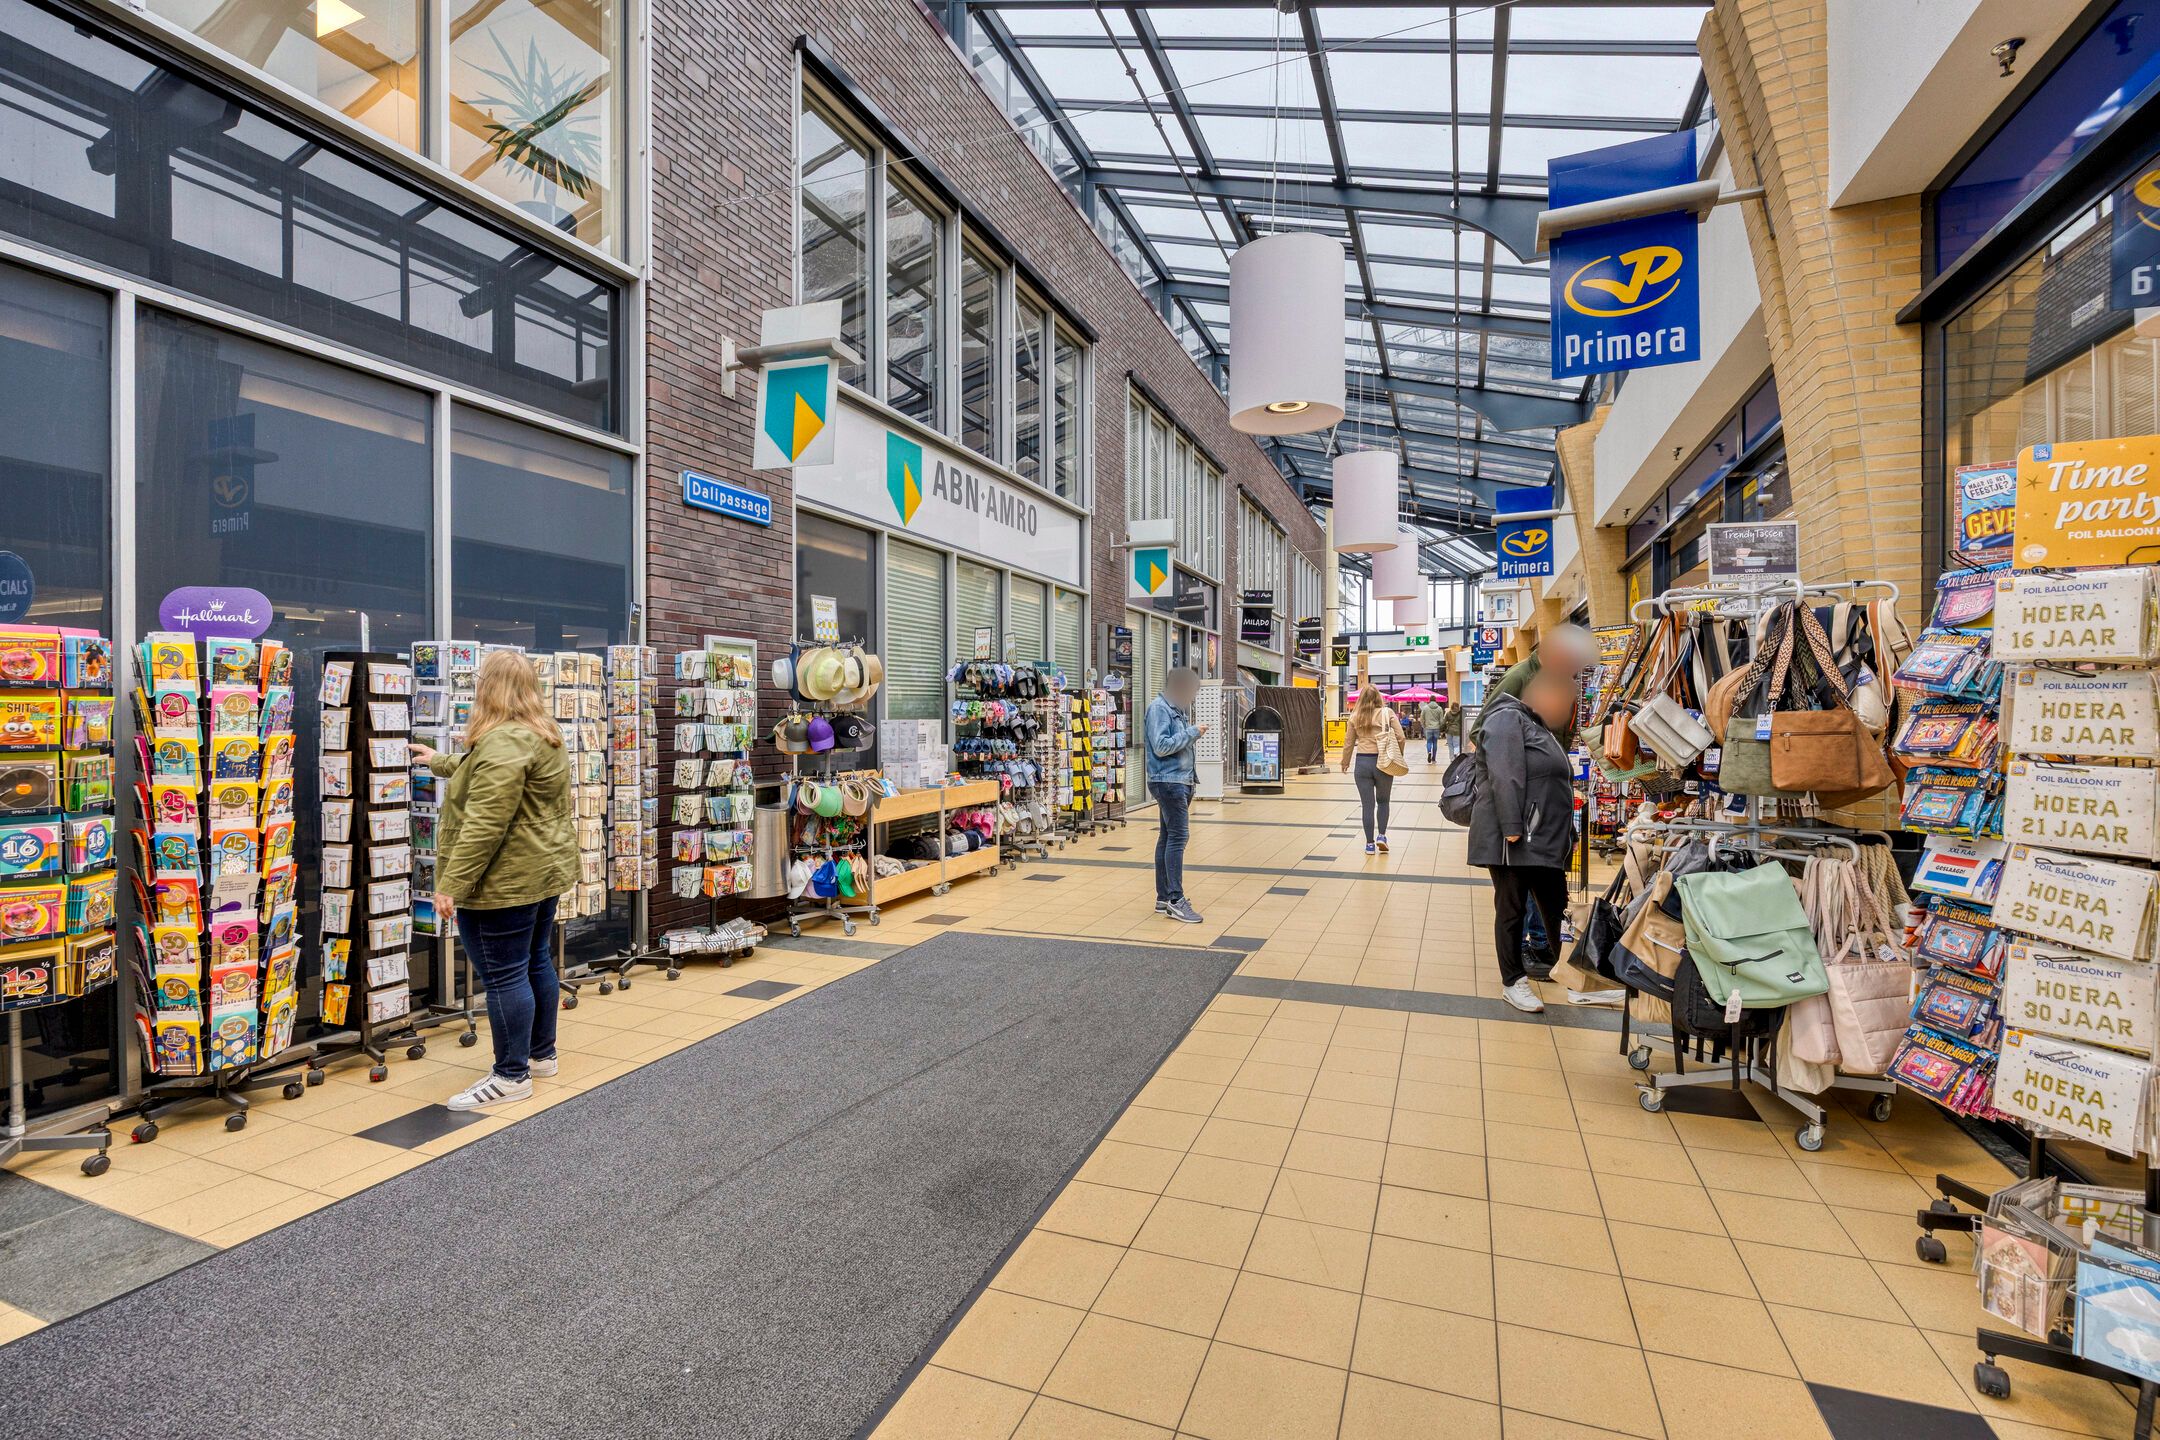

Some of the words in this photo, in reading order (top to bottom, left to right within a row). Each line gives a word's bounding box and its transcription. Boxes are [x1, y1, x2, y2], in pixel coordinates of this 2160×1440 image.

[1566, 326, 1686, 367] Primera
[2048, 459, 2149, 492] Time
[1968, 480, 1985, 490] WAAR
[1970, 480, 2009, 498] FEESTJE?
[692, 480, 768, 517] Dalipassage
[2054, 491, 2160, 530] party
[2068, 530, 2093, 540] FOIL
[2096, 526, 2153, 538] BALLOON
[1501, 560, 1549, 576] Primera
[2023, 586, 2042, 595] FOIL
[2044, 584, 2090, 593] BALLOON
[2092, 582, 2108, 591] KIT
[172, 607, 260, 628] Hallmark
[1243, 618, 1270, 627] MILADO
[2021, 603, 2107, 625] HOERA
[1300, 638, 1320, 646] MILADO
[1485, 632, 1495, 641] K
[2011, 631, 2034, 649] 16
[2043, 628, 2117, 648] JAAR
[159, 648, 182, 666] 20
[2043, 682, 2063, 690] FOIL
[2064, 682, 2109, 690] BALLOON
[2111, 682, 2128, 690] KIT
[6, 703, 31, 713] SHIT
[163, 696, 186, 712] 21
[223, 696, 250, 712] 40
[1918, 704, 1932, 714] XXL
[2041, 702, 2126, 720] HOERA
[2030, 724, 2054, 743] 18
[2061, 726, 2135, 745] JAAR
[162, 745, 183, 761] 21
[225, 742, 252, 758] 40
[1921, 774, 1933, 785] XXL
[1934, 774, 1979, 787] GEVELVLAGGEN
[2035, 775, 2055, 784] FOIL
[2057, 776, 2102, 786] BALLOON
[2104, 779, 2121, 787] KIT
[163, 790, 185, 809] 25
[220, 790, 248, 805] 40
[2033, 793, 2119, 818] HOERA
[2021, 817, 2045, 836] 21
[2054, 820, 2129, 845] JAAR
[2, 838, 40, 859] 16
[88, 830, 106, 850] 18
[162, 839, 186, 857] 25
[223, 836, 248, 851] 45
[1960, 848, 1976, 856] FLAG
[2034, 862, 2053, 874] FOIL
[2055, 866, 2099, 884] BALLOON
[2101, 878, 2117, 887] KIT
[2027, 880, 2109, 917] HOERA
[1936, 904, 1949, 917] XXL
[2011, 901, 2039, 922] 25
[2042, 908, 2115, 943] JAAR
[163, 935, 186, 949] 30
[224, 928, 249, 944] 50
[2036, 960, 2055, 970] FOIL
[2058, 962, 2103, 976] BALLOON
[2105, 969, 2122, 979] KIT
[1, 966, 48, 998] 12
[164, 982, 189, 997] 30
[223, 973, 250, 990] 50
[1935, 970, 1948, 982] XXL
[1948, 974, 1994, 996] GEVELVLAGGEN
[17, 998, 42, 1006] SPECIALS
[2035, 979, 2122, 1010] HOERA
[222, 1019, 249, 1036] 50
[2023, 1000, 2052, 1021] 30
[2058, 1007, 2134, 1038] JAAR
[163, 1028, 188, 1045] 35
[1913, 1031, 1926, 1045] XXL
[1926, 1037, 1977, 1064] GEVELVLAGGEN
[2094, 1069, 2111, 1080] KIT
[2024, 1068, 2105, 1110] HOERA
[2011, 1088, 2038, 1111] 40
[2042, 1100, 2113, 1137] JAAR
